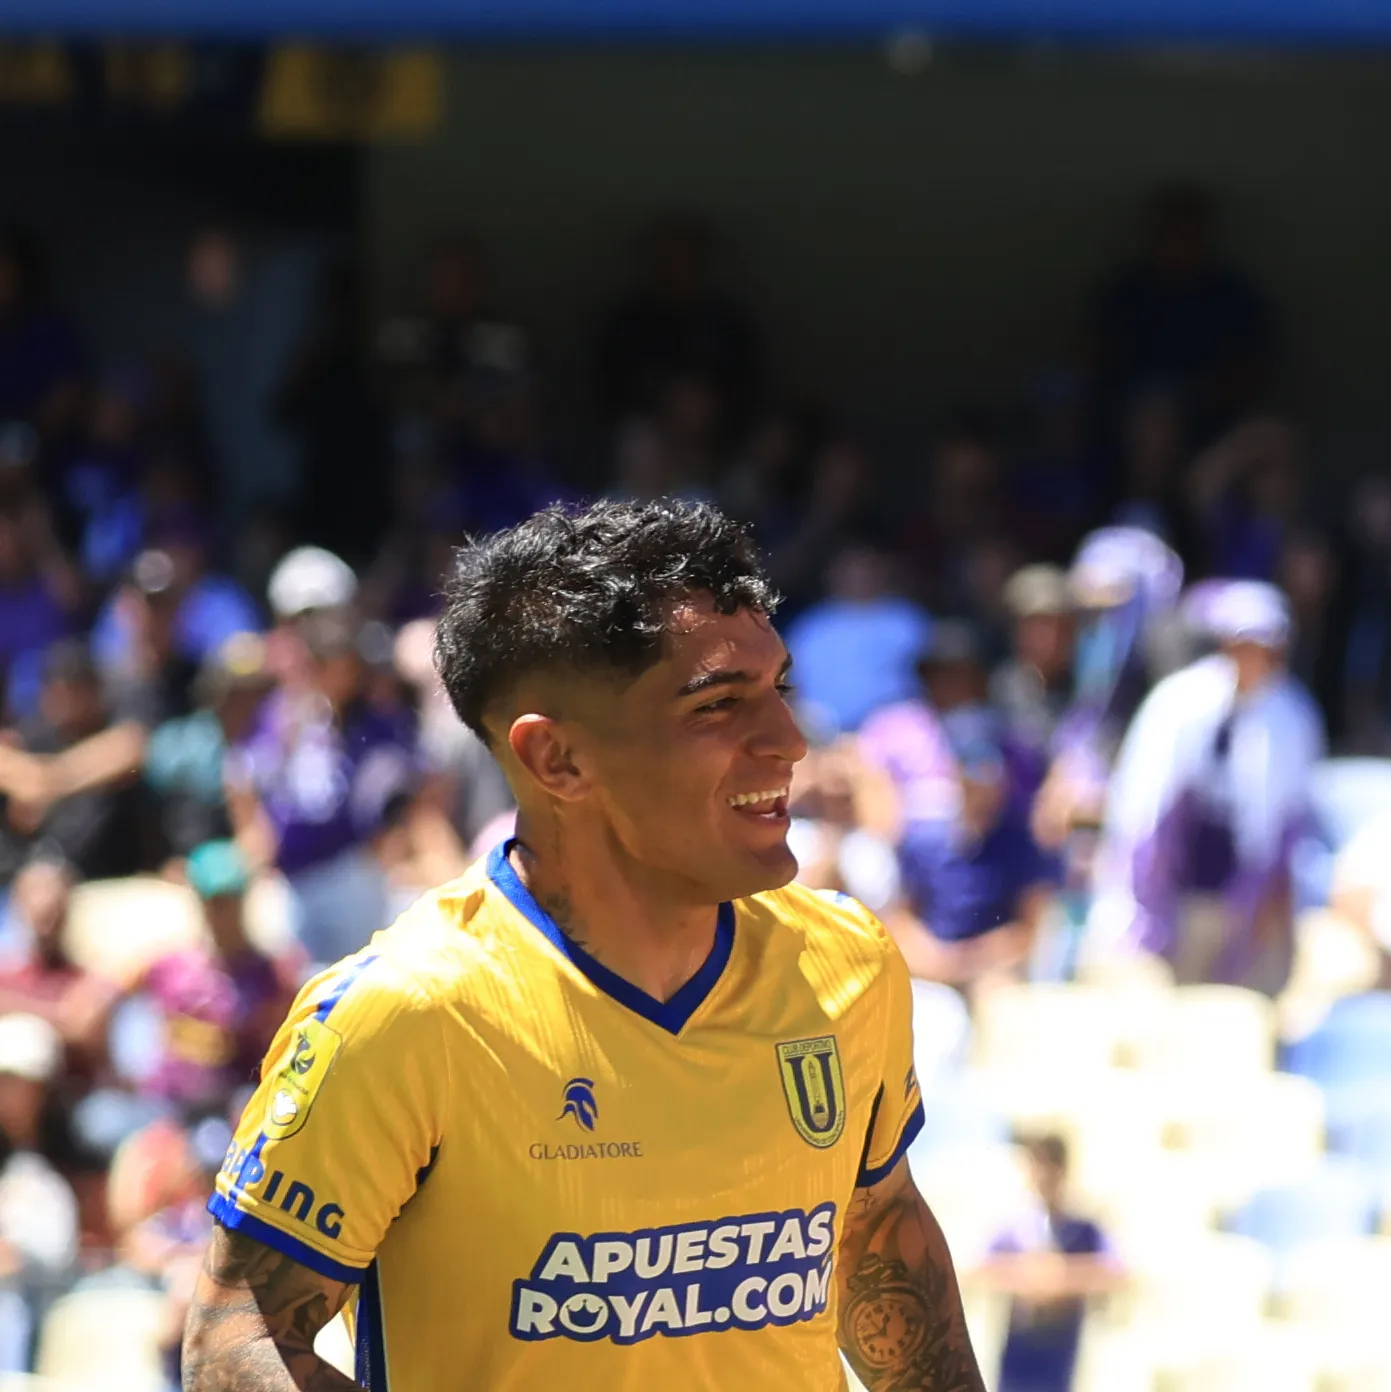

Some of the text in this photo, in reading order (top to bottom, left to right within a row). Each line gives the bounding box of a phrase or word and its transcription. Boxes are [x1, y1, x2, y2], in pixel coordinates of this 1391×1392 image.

[528, 1141, 644, 1161] GLADIATORE
[538, 1210, 833, 1284] APUESTAS
[516, 1258, 833, 1338] ROYAL.COM
